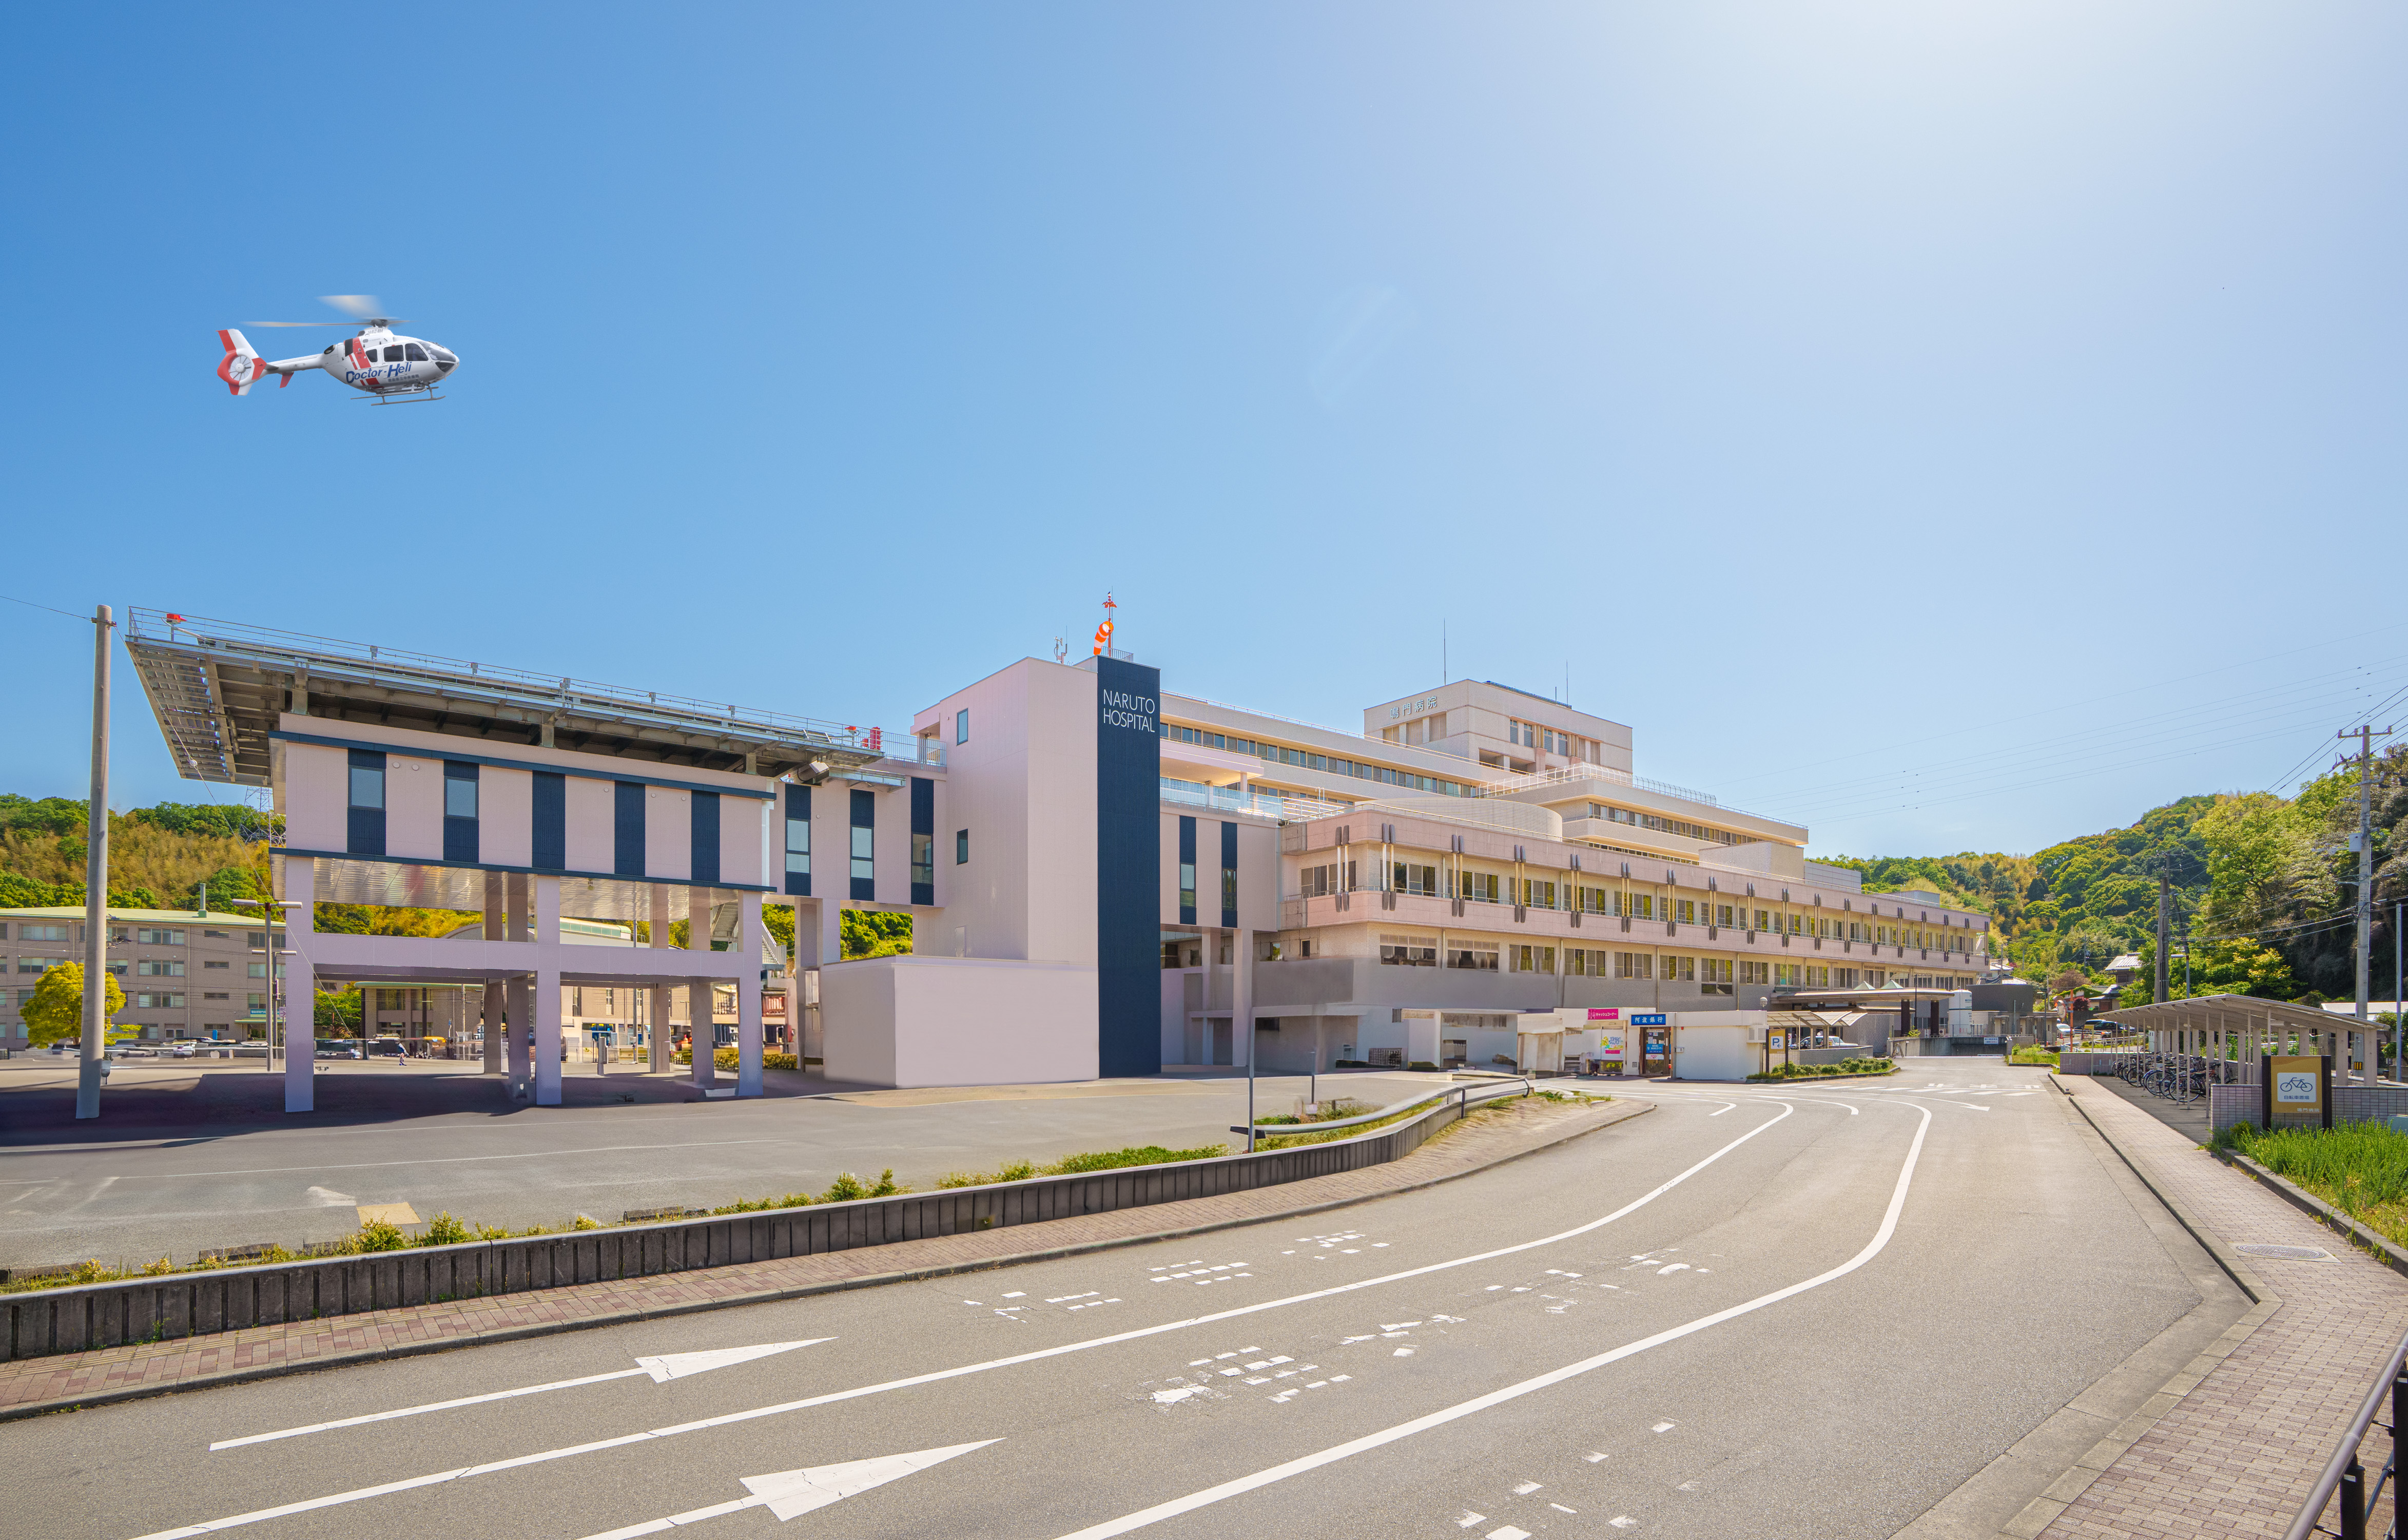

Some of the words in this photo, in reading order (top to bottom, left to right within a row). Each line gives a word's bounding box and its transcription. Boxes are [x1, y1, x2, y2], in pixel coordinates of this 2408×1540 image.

[1103, 689, 1155, 714] NARUTO
[1390, 696, 1437, 719] 鳴門病院
[1103, 707, 1155, 733] HOSPITAL
